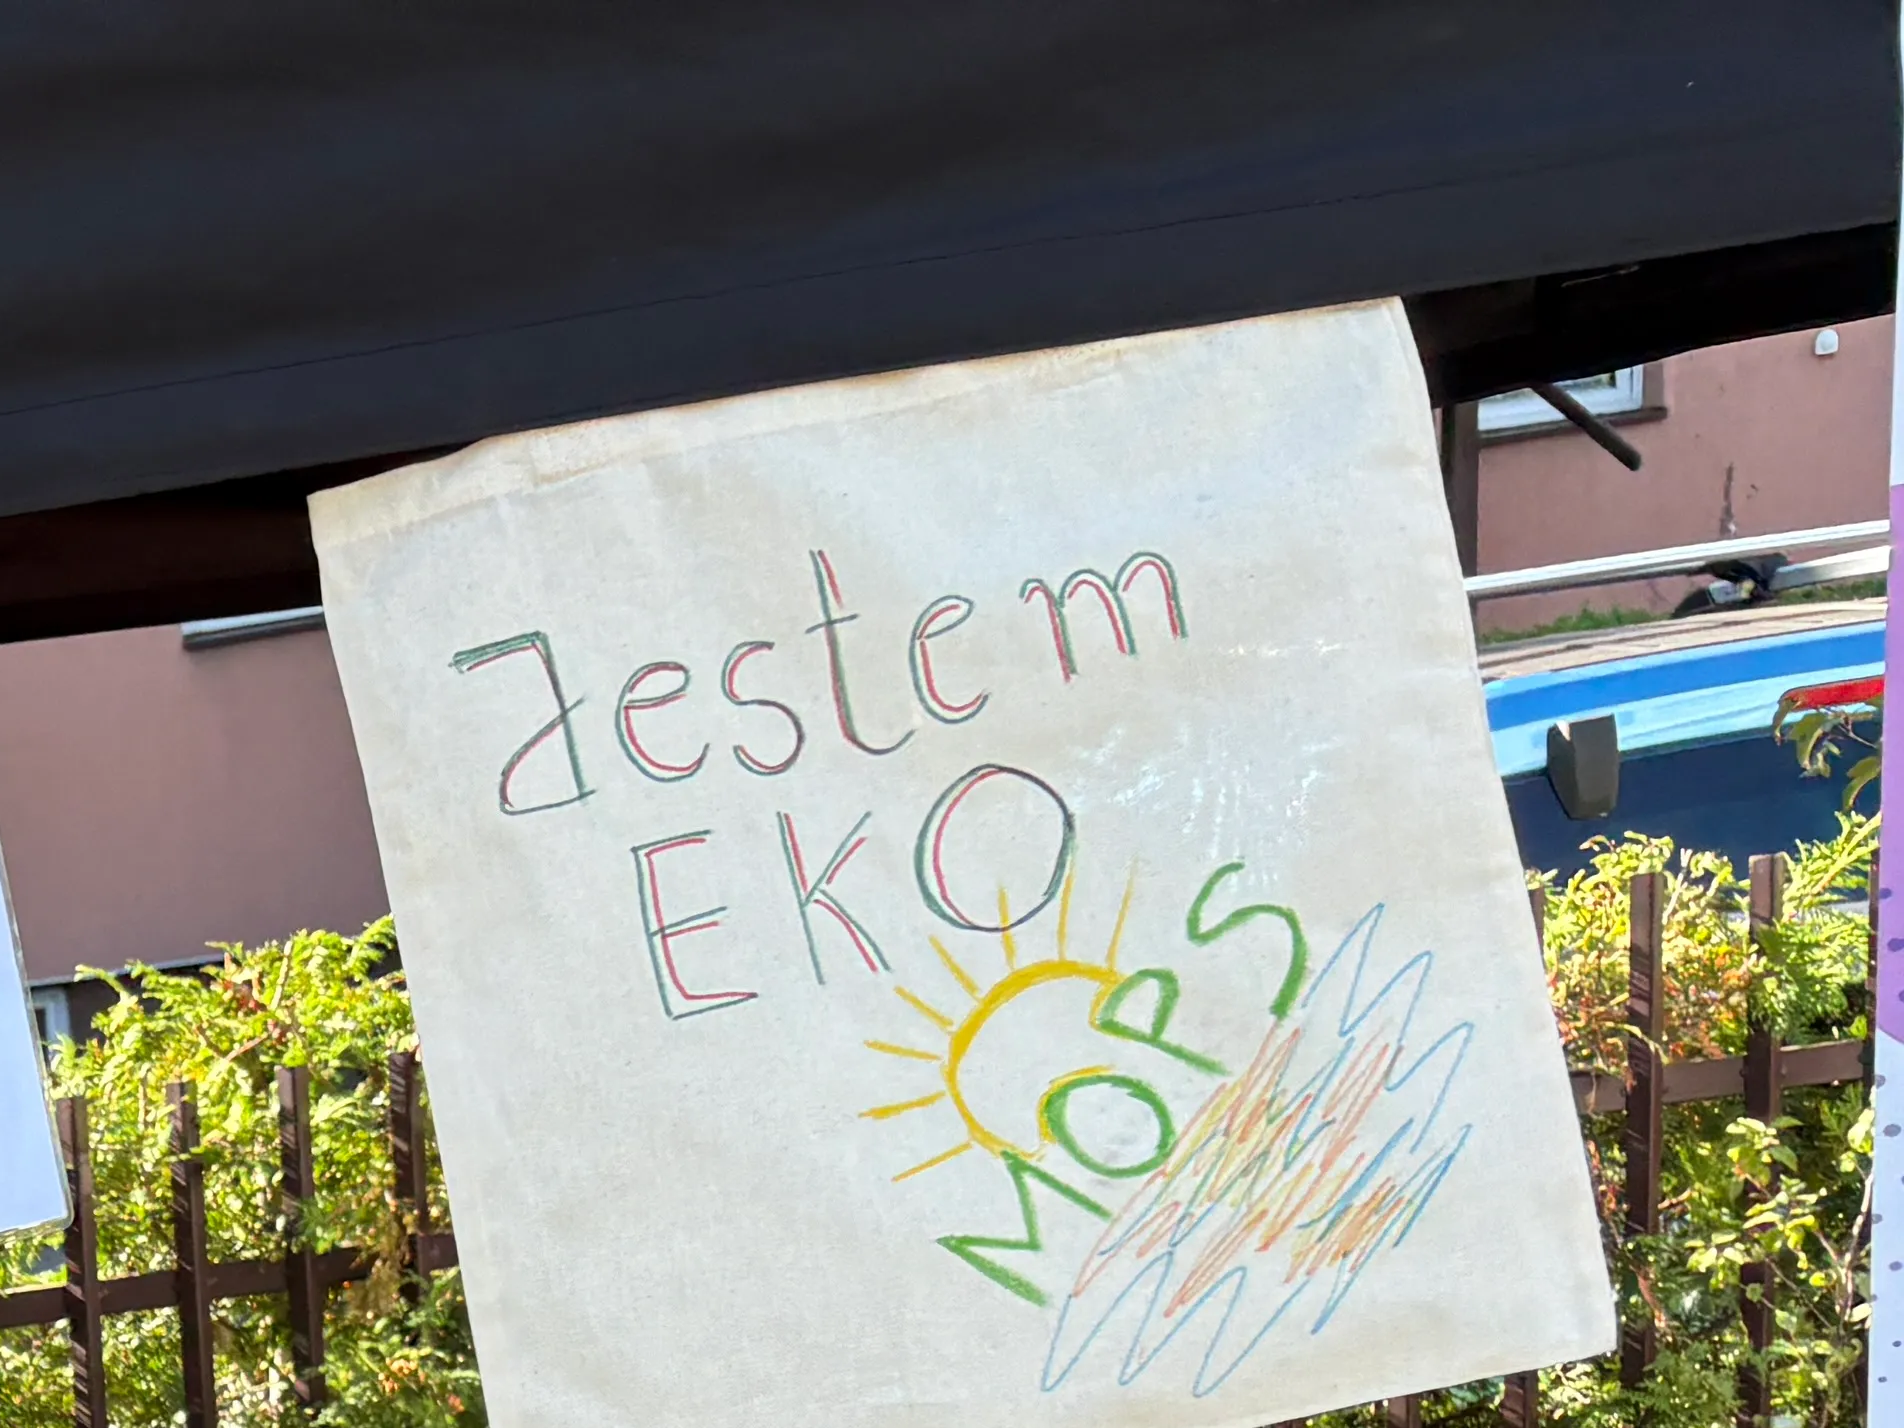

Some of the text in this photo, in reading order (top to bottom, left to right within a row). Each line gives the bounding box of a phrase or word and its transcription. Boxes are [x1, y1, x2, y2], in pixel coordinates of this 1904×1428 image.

[448, 550, 1189, 818] Jestem
[632, 764, 1077, 1020] EKO
[937, 862, 1308, 1306] MOPS
